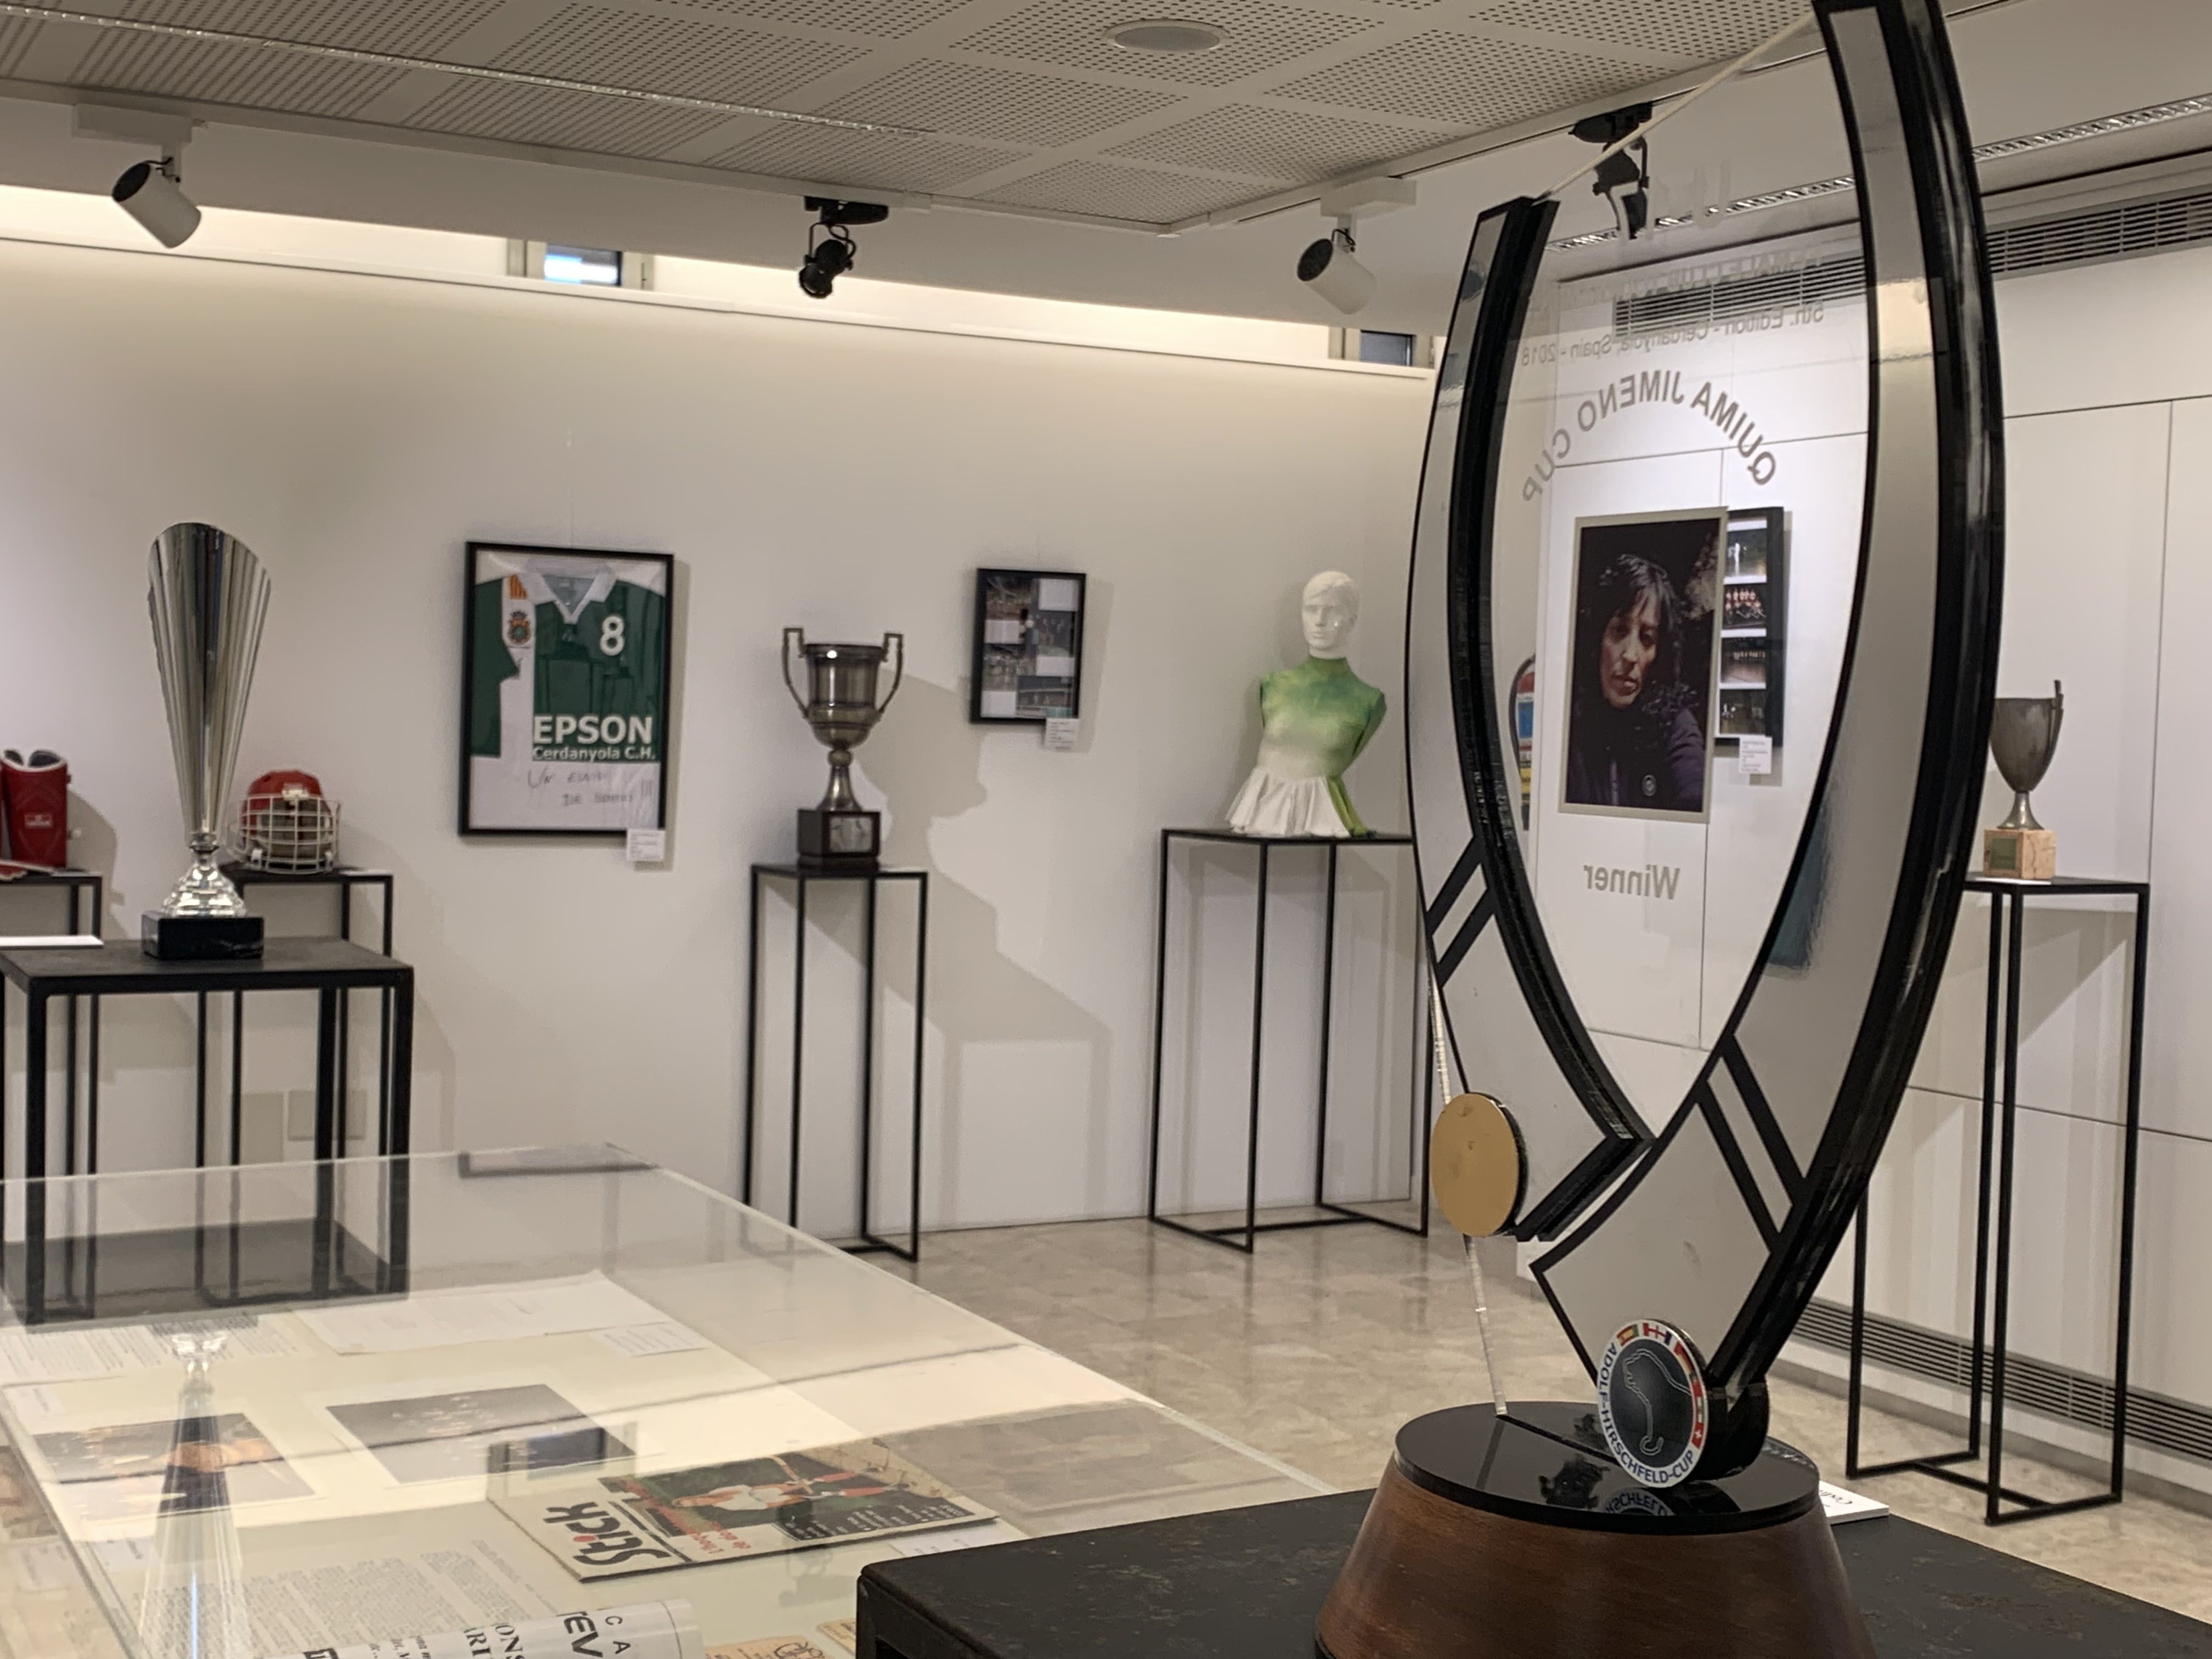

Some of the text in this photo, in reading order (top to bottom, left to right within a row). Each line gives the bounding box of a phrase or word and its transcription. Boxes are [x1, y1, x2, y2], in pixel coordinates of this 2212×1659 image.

[600, 614, 625, 657] 8
[533, 714, 653, 744] EPSON
[532, 744, 656, 763] Cerdanyola C.H.
[543, 1501, 672, 1566] Stick
